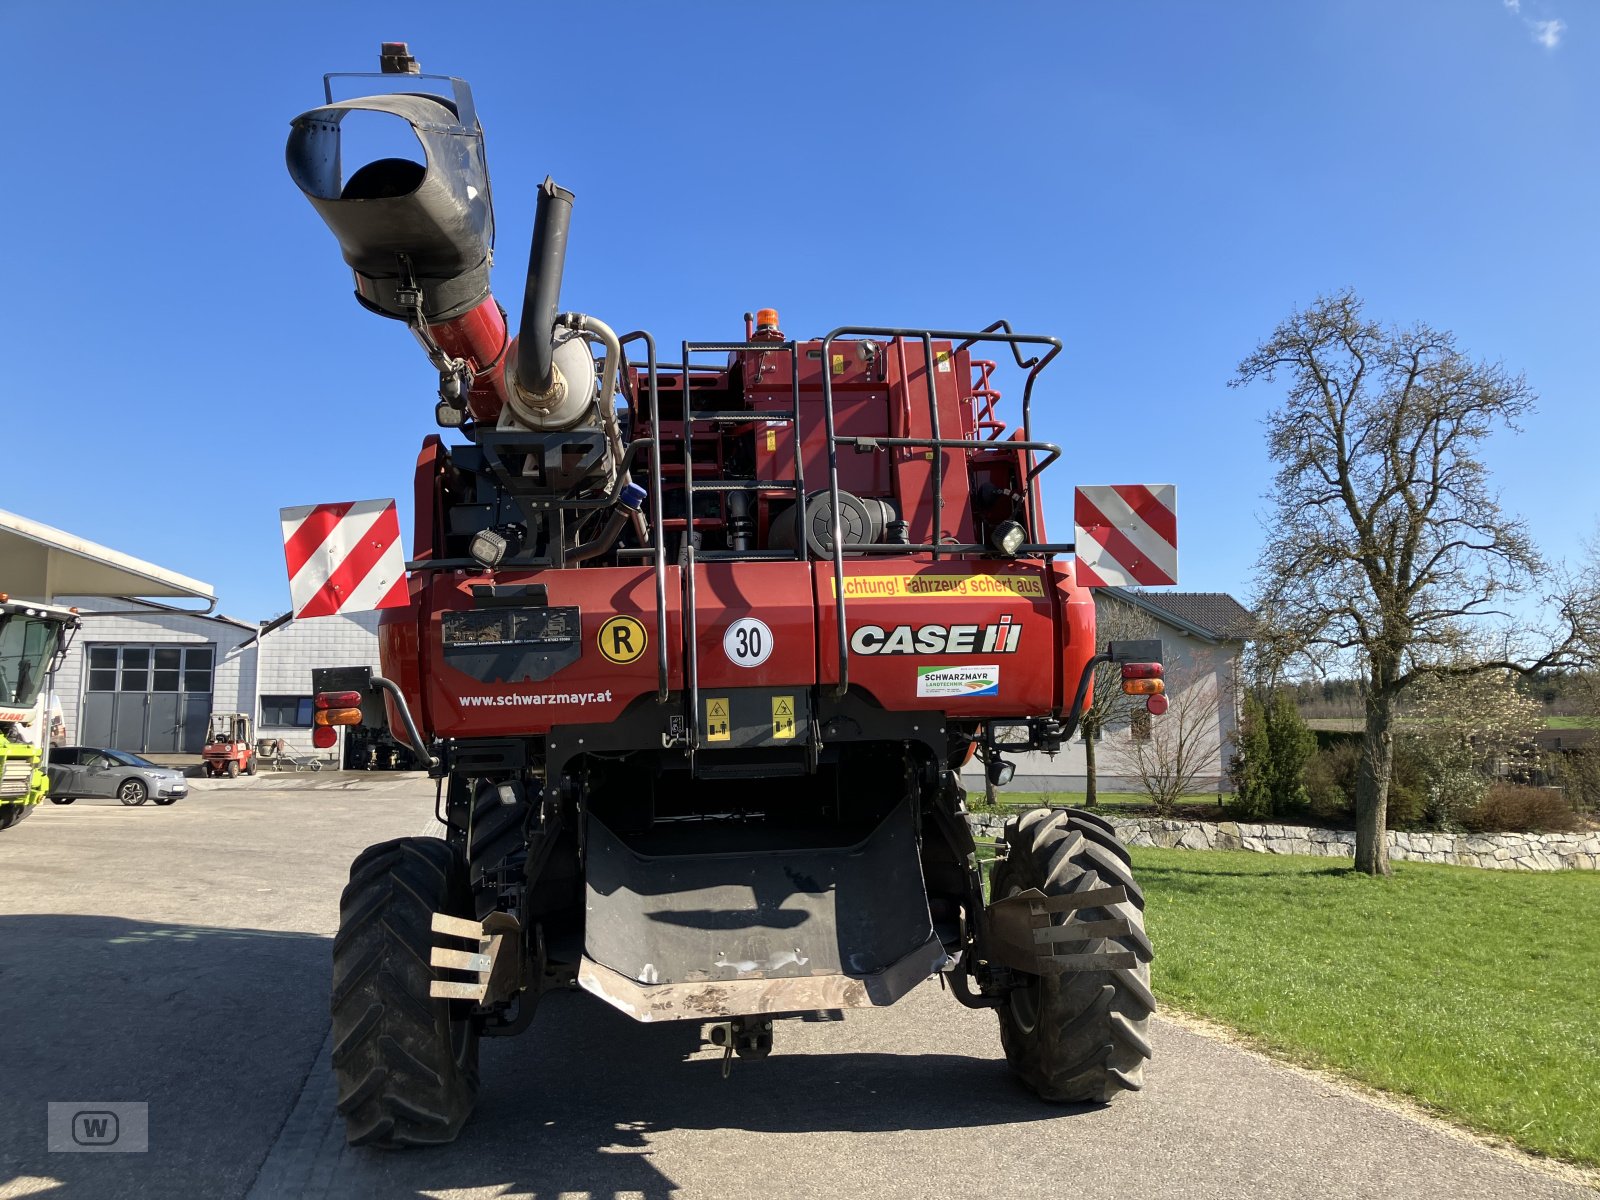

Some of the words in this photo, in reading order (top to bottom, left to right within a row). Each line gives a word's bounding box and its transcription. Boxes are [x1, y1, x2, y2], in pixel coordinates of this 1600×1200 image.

[843, 577, 899, 595] chtung!
[903, 576, 967, 594] Fahrzeug
[971, 577, 1014, 592] schert
[612, 625, 634, 655] R
[735, 627, 762, 658] 30
[850, 624, 980, 656] CASE
[925, 673, 988, 681] SCHWARZMAYR
[459, 689, 612, 707] www.schwarzmayr.at
